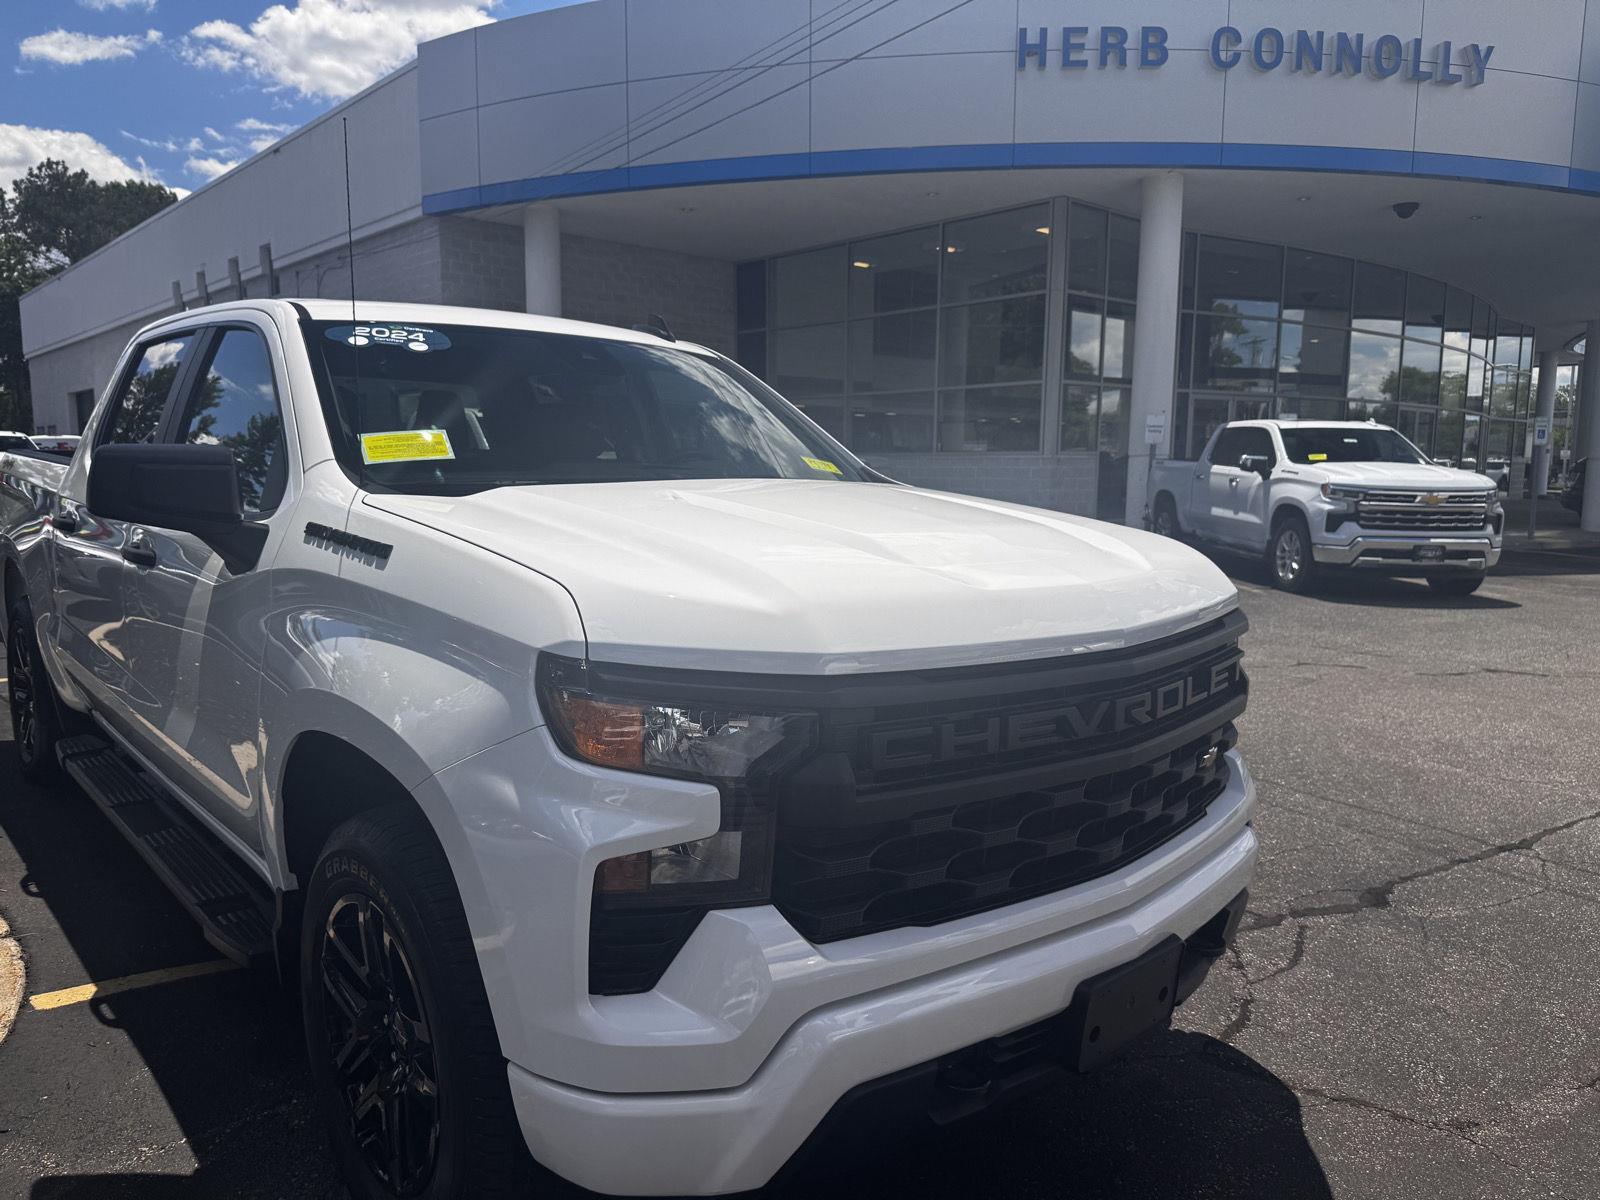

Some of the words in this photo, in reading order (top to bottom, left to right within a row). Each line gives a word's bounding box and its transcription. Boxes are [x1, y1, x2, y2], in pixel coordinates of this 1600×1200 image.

[1017, 26, 1169, 71] HERB
[1209, 26, 1496, 87] CONNOLLY
[353, 326, 426, 342] 2024
